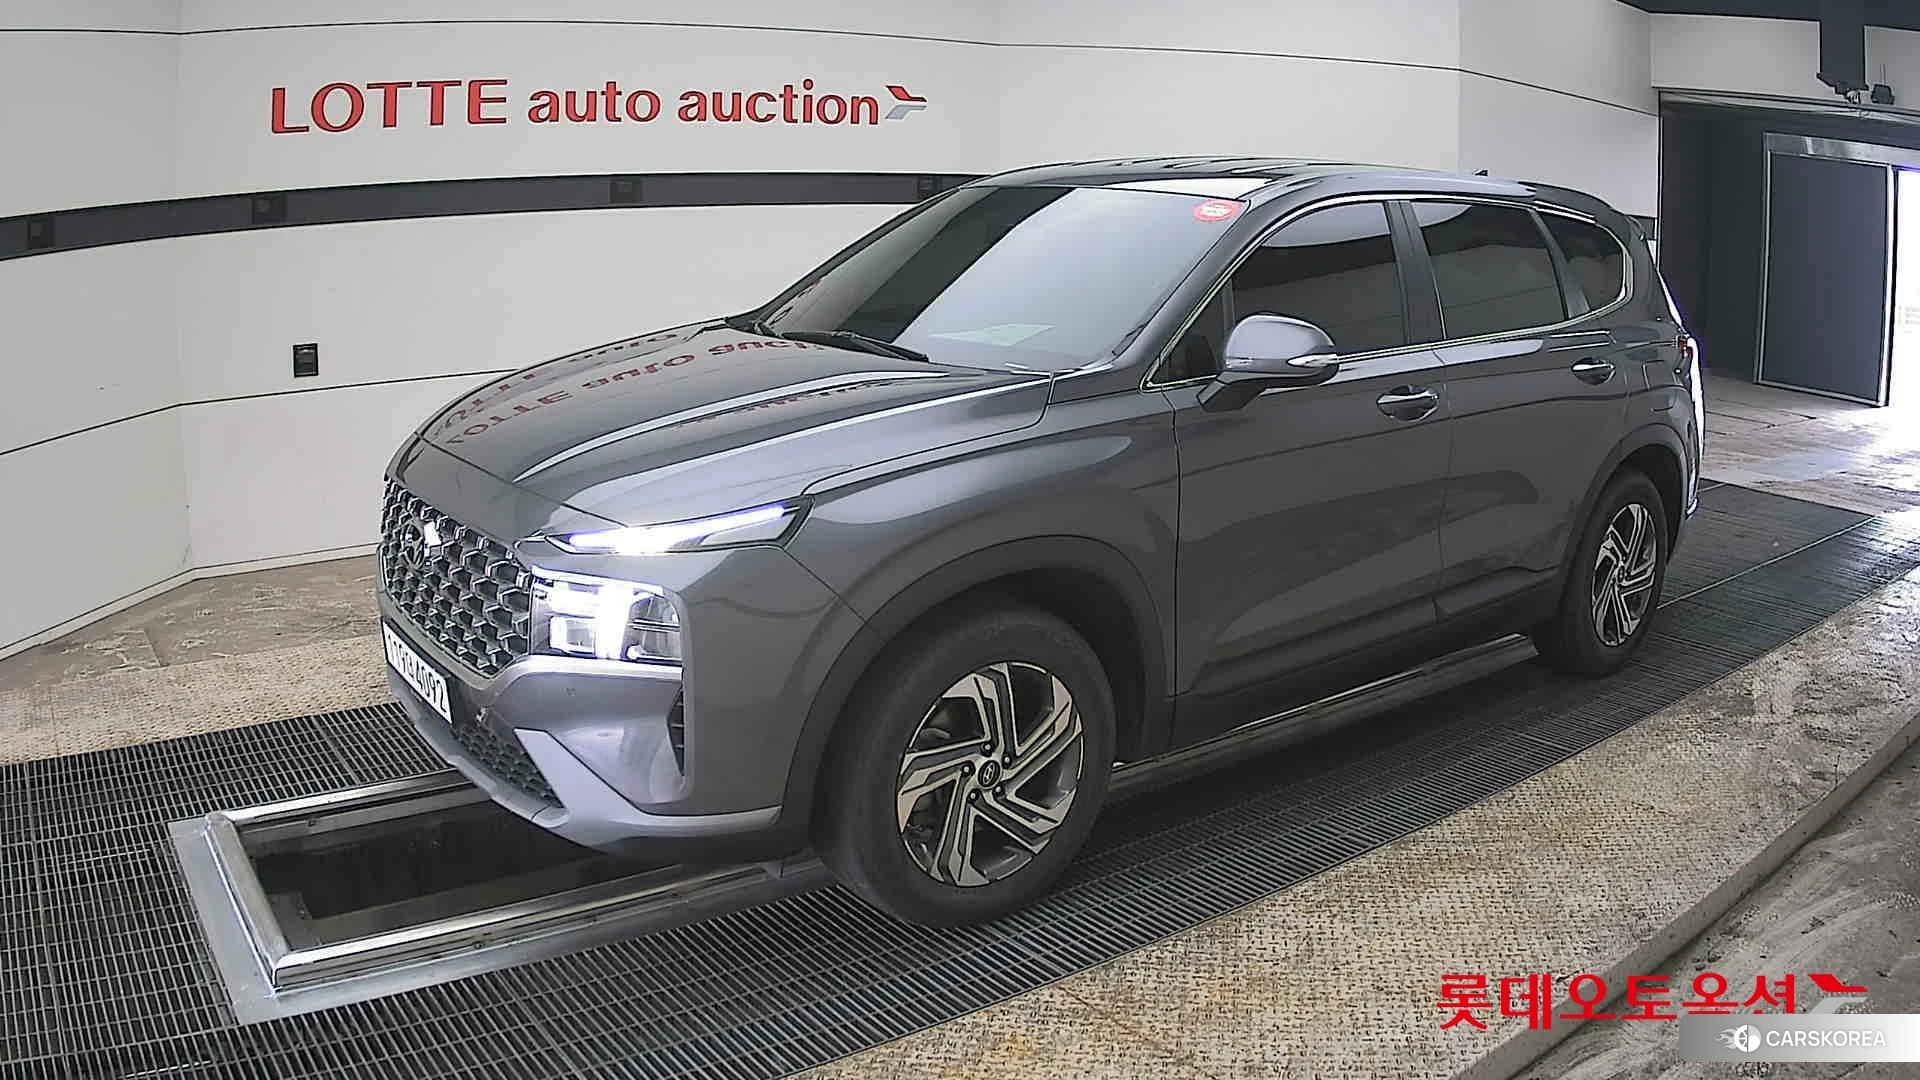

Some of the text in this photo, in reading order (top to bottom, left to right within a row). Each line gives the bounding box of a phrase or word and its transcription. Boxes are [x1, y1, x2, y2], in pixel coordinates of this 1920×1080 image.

[271, 79, 879, 135] LOTTE auto auction
